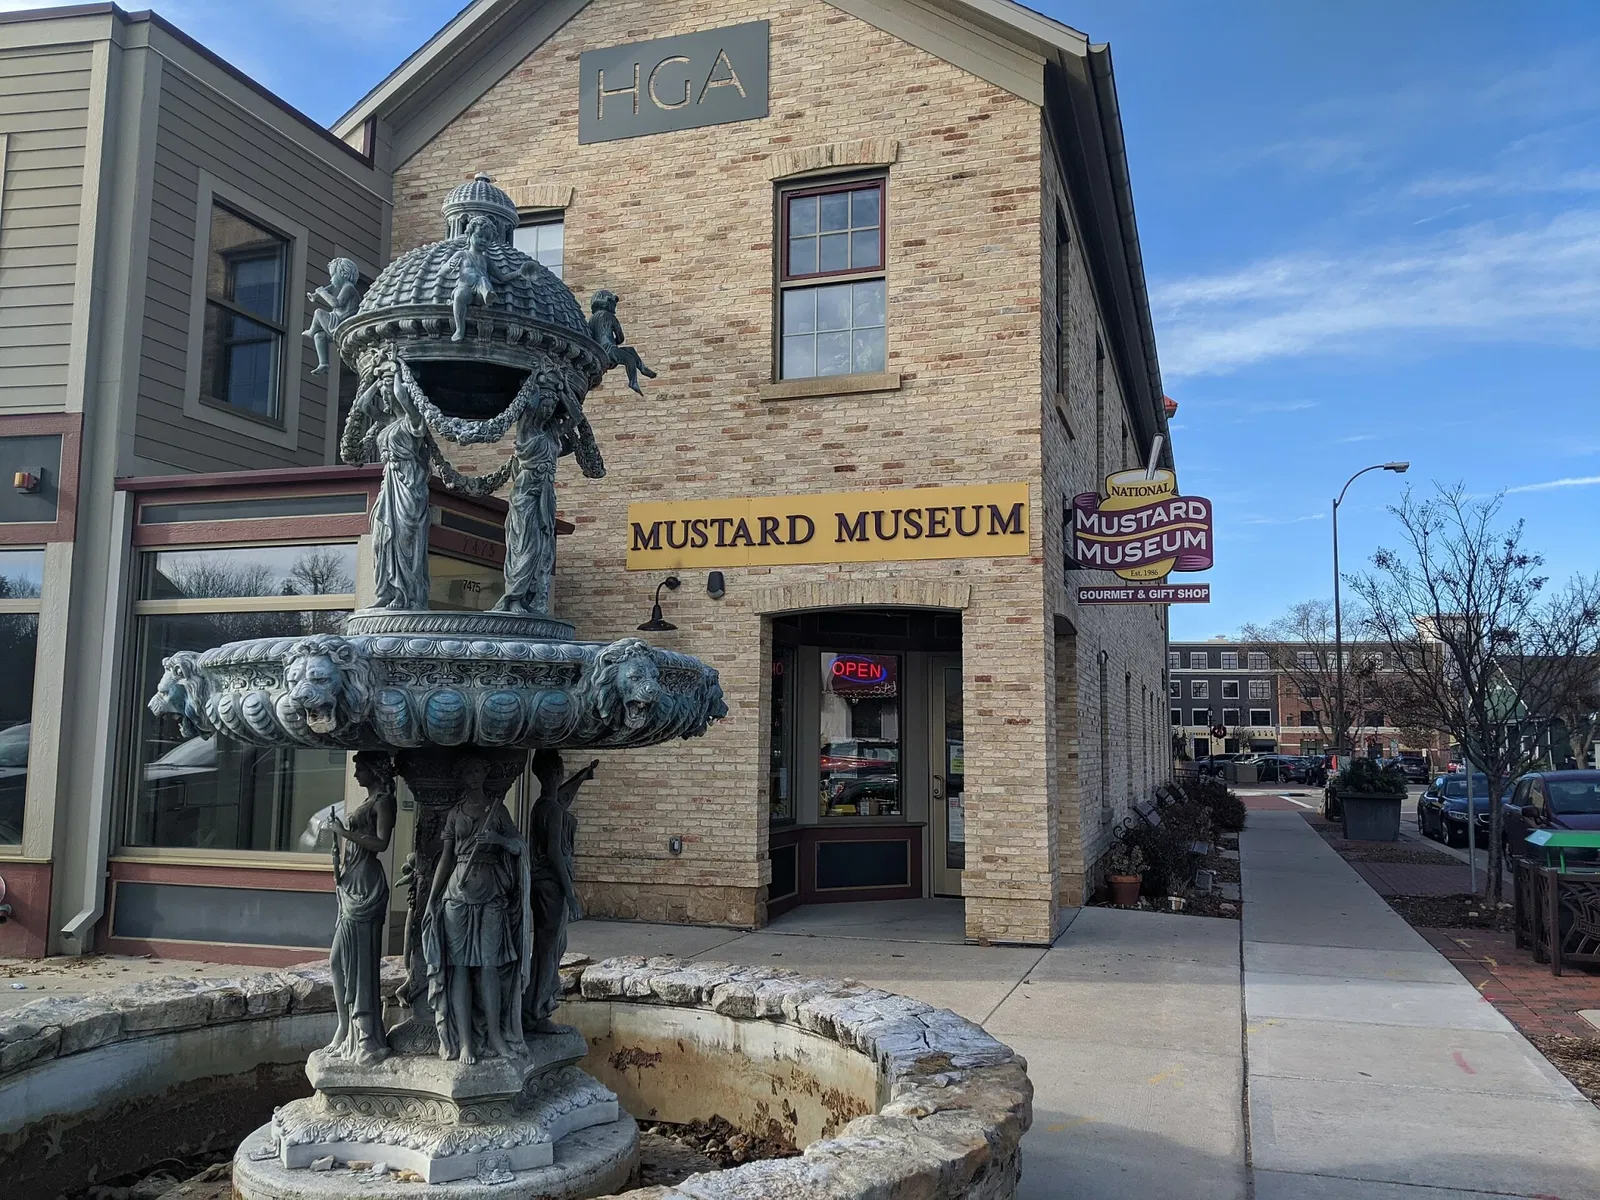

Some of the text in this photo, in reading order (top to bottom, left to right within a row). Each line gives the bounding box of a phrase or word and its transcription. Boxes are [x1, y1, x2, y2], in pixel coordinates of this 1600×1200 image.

[597, 48, 747, 120] HGA
[1111, 483, 1170, 497] NATIONAL
[630, 502, 1025, 551] MUSTARD MUSEUM
[1076, 501, 1207, 535] MUSTARD
[1077, 531, 1207, 565] MUSEUM
[463, 579, 481, 593] 7475
[1079, 588, 1209, 600] GOURMET & GIFT SHOP
[832, 661, 881, 678] OPEN
